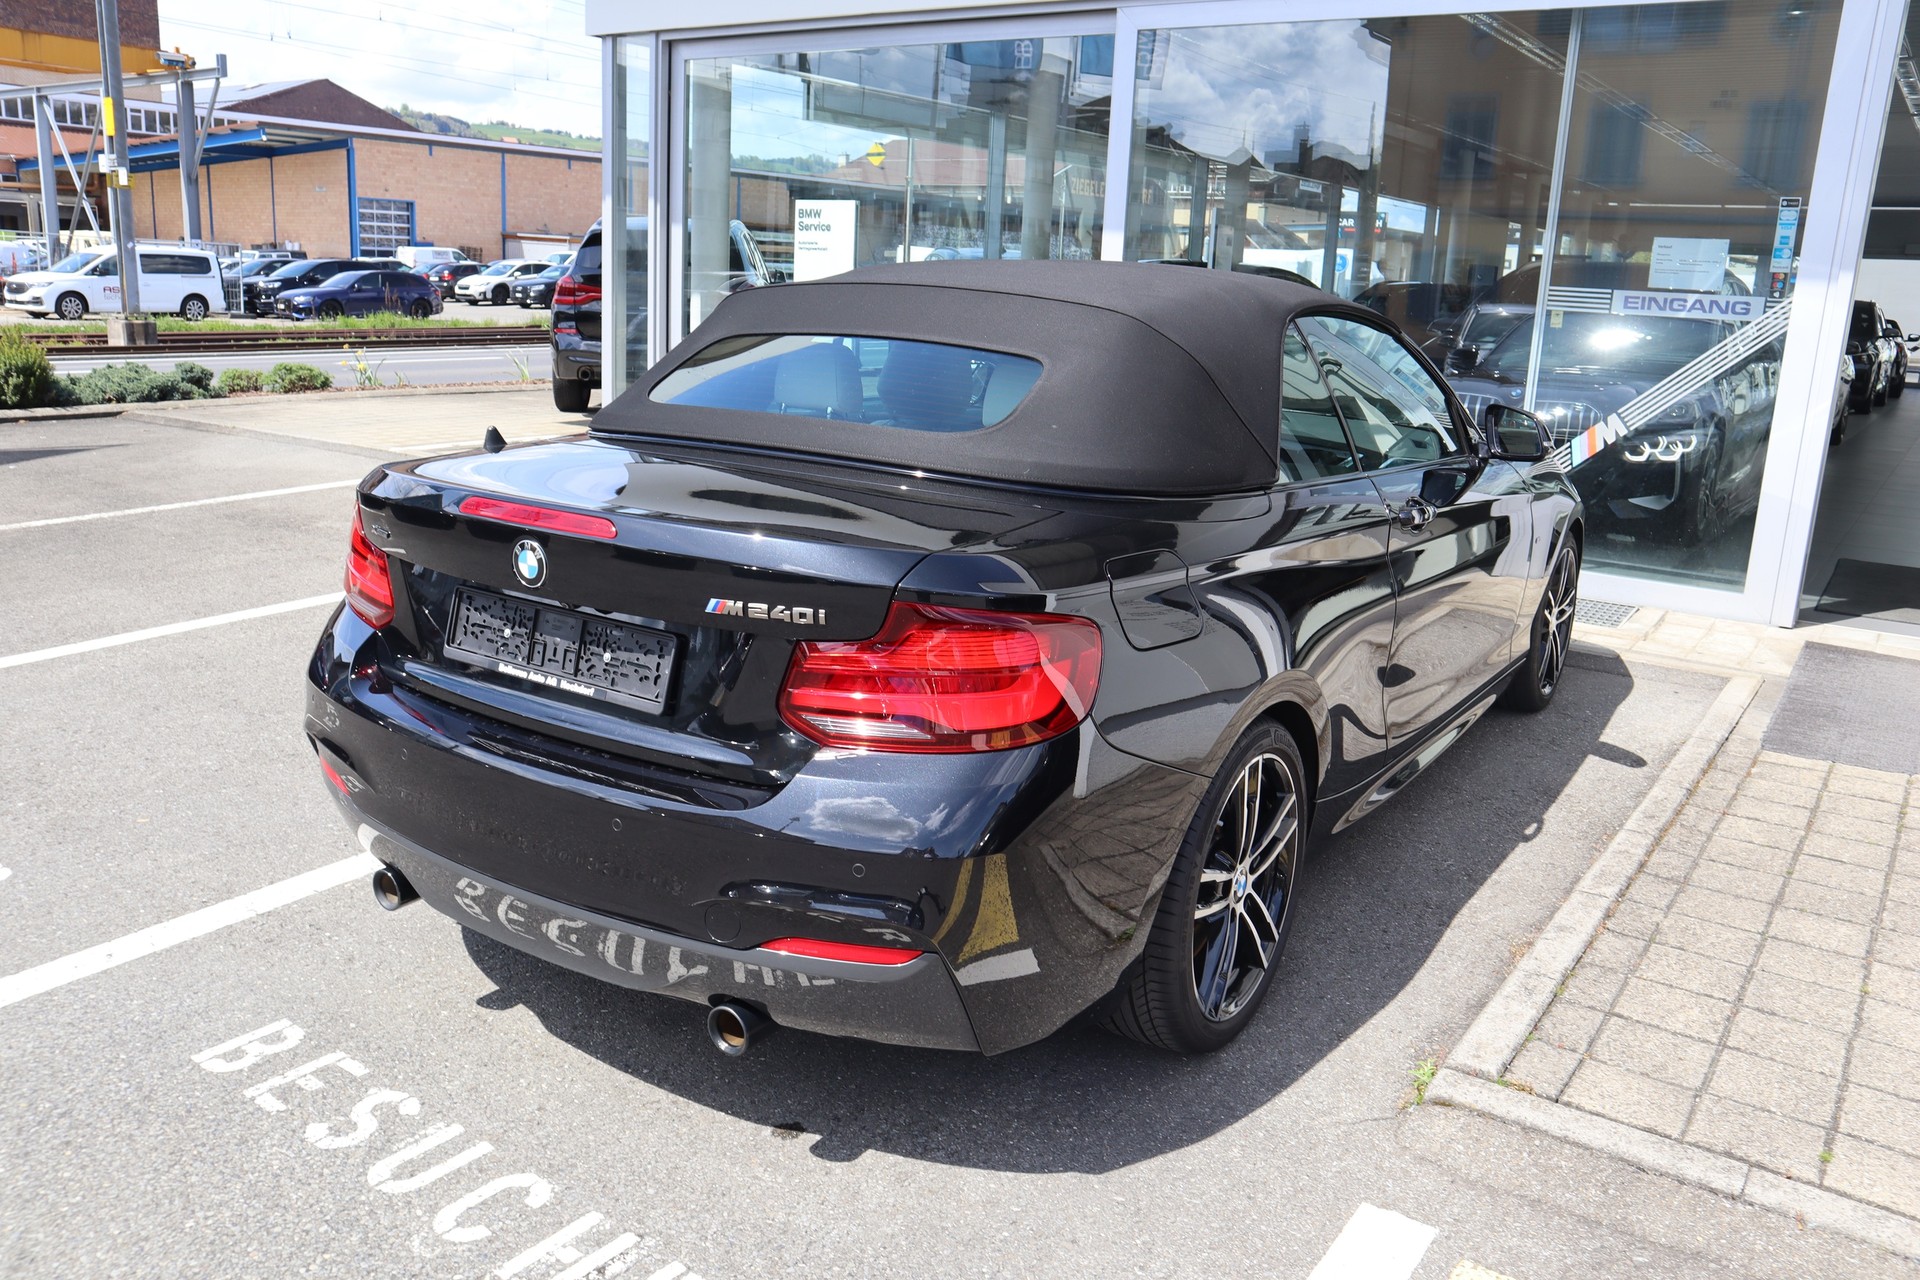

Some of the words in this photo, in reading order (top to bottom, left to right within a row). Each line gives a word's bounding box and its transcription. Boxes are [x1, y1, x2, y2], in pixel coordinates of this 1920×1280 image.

[798, 208, 822, 219] BMW
[798, 220, 832, 232] Service
[1622, 295, 1752, 316] EINGANG
[1595, 412, 1629, 450] M
[545, 675, 558, 687] AG
